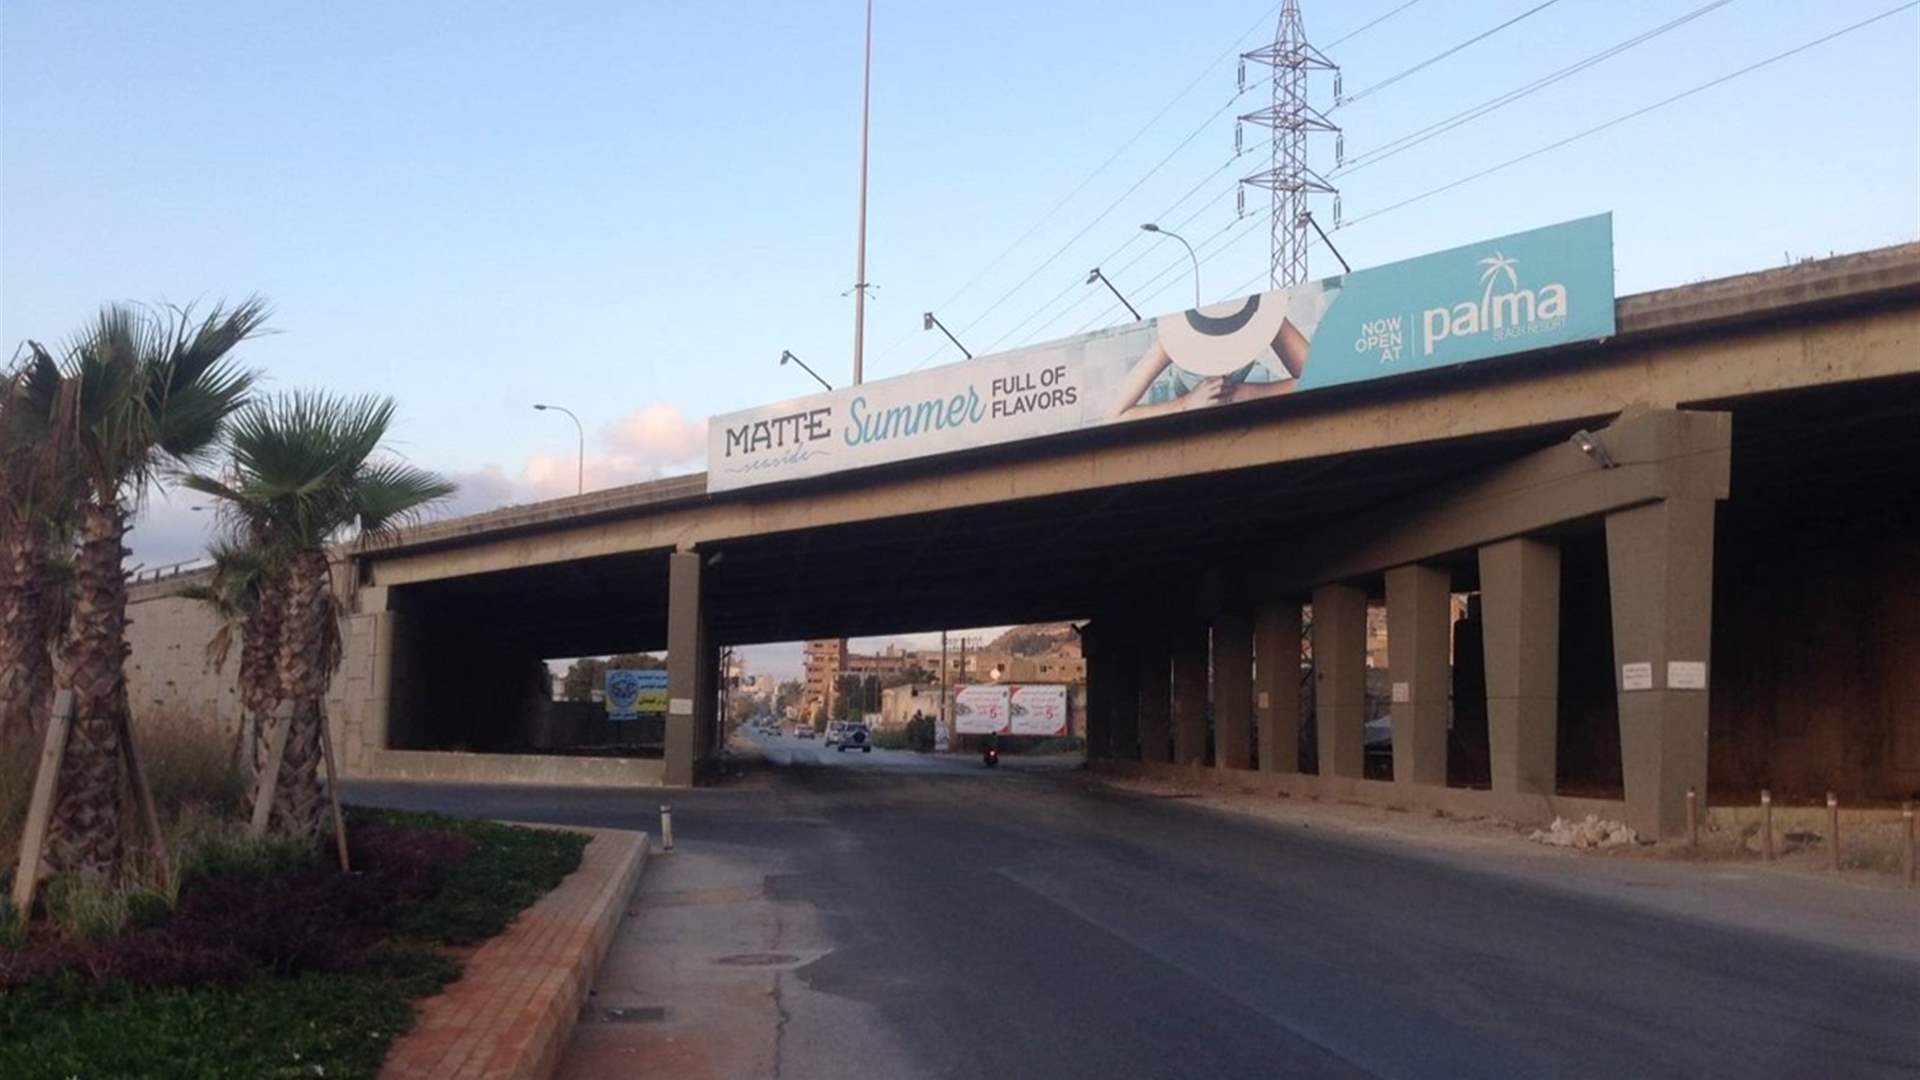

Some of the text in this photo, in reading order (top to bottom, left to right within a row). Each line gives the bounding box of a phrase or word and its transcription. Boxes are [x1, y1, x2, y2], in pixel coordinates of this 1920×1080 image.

[1423, 251, 1567, 356] palma
[1362, 318, 1401, 336] NOW
[1355, 333, 1402, 353] OPEN
[1380, 350, 1402, 364] AT
[991, 366, 1066, 397] FULL OF
[844, 385, 987, 447] Summer
[991, 387, 1077, 418] FLAVORS
[725, 407, 831, 457] MATTE
